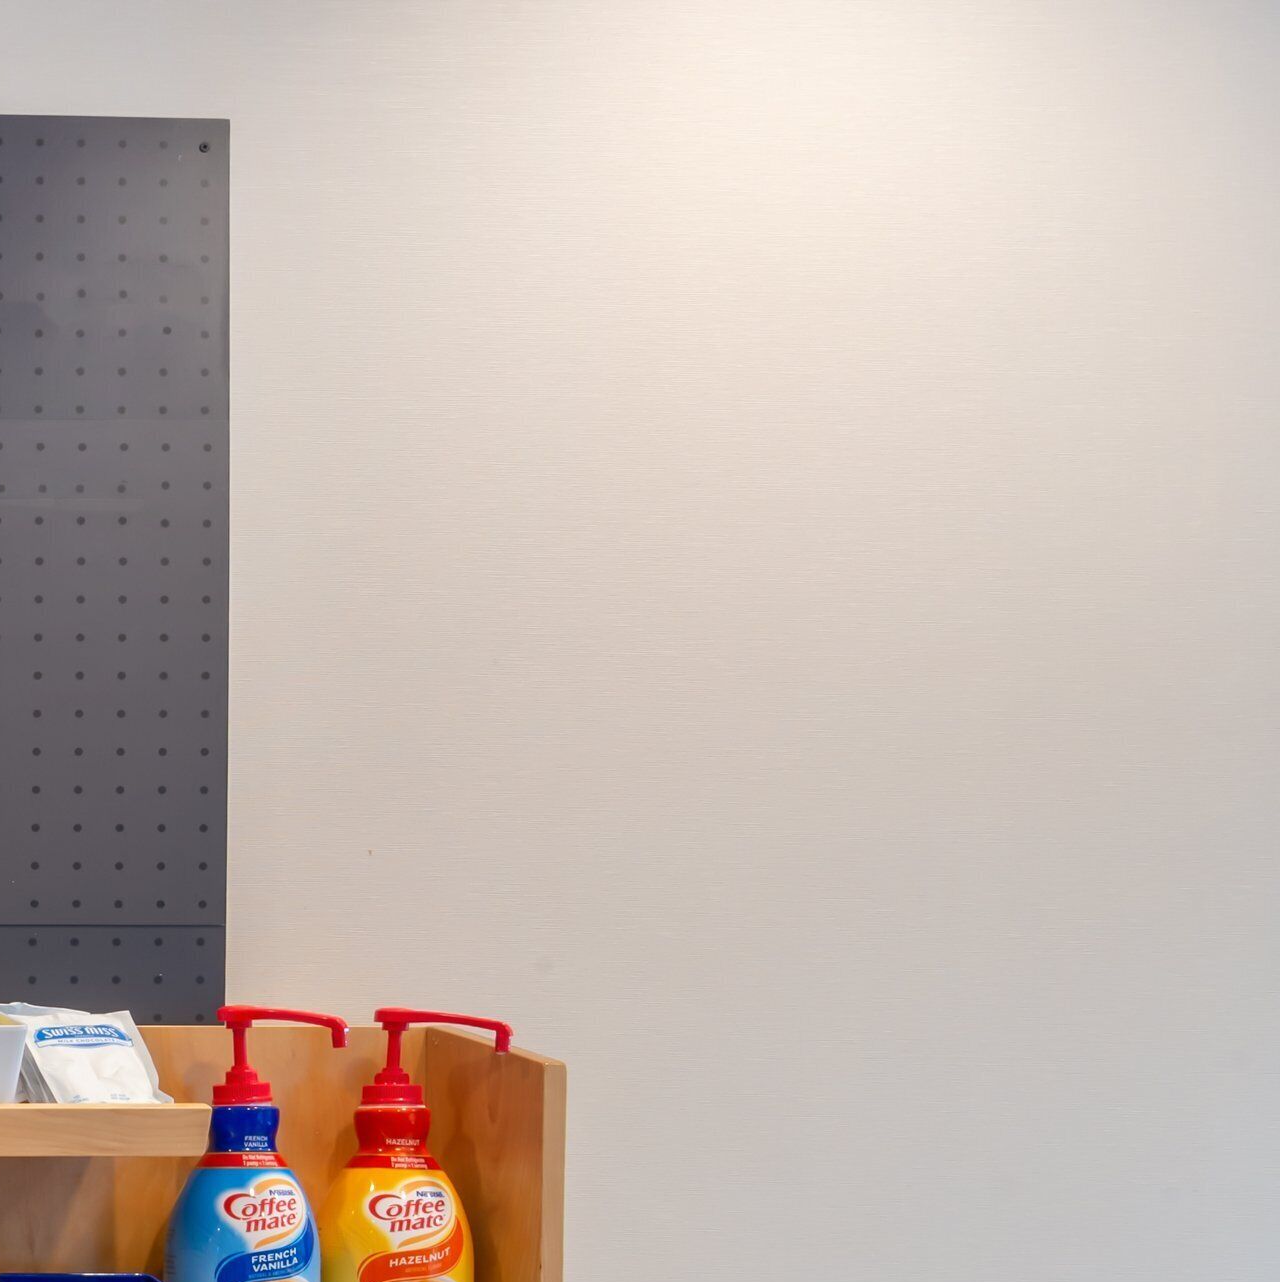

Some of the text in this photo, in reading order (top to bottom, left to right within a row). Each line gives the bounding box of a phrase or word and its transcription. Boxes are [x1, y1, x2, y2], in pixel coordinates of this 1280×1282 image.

[224, 1193, 297, 1220] Coffee
[368, 1194, 446, 1220] Coffee
[246, 1213, 297, 1232] mate
[389, 1215, 445, 1232] mate
[251, 1248, 297, 1264] FRENCH
[253, 1257, 298, 1272] VANILLA
[389, 1247, 451, 1267] HAZELNUT
